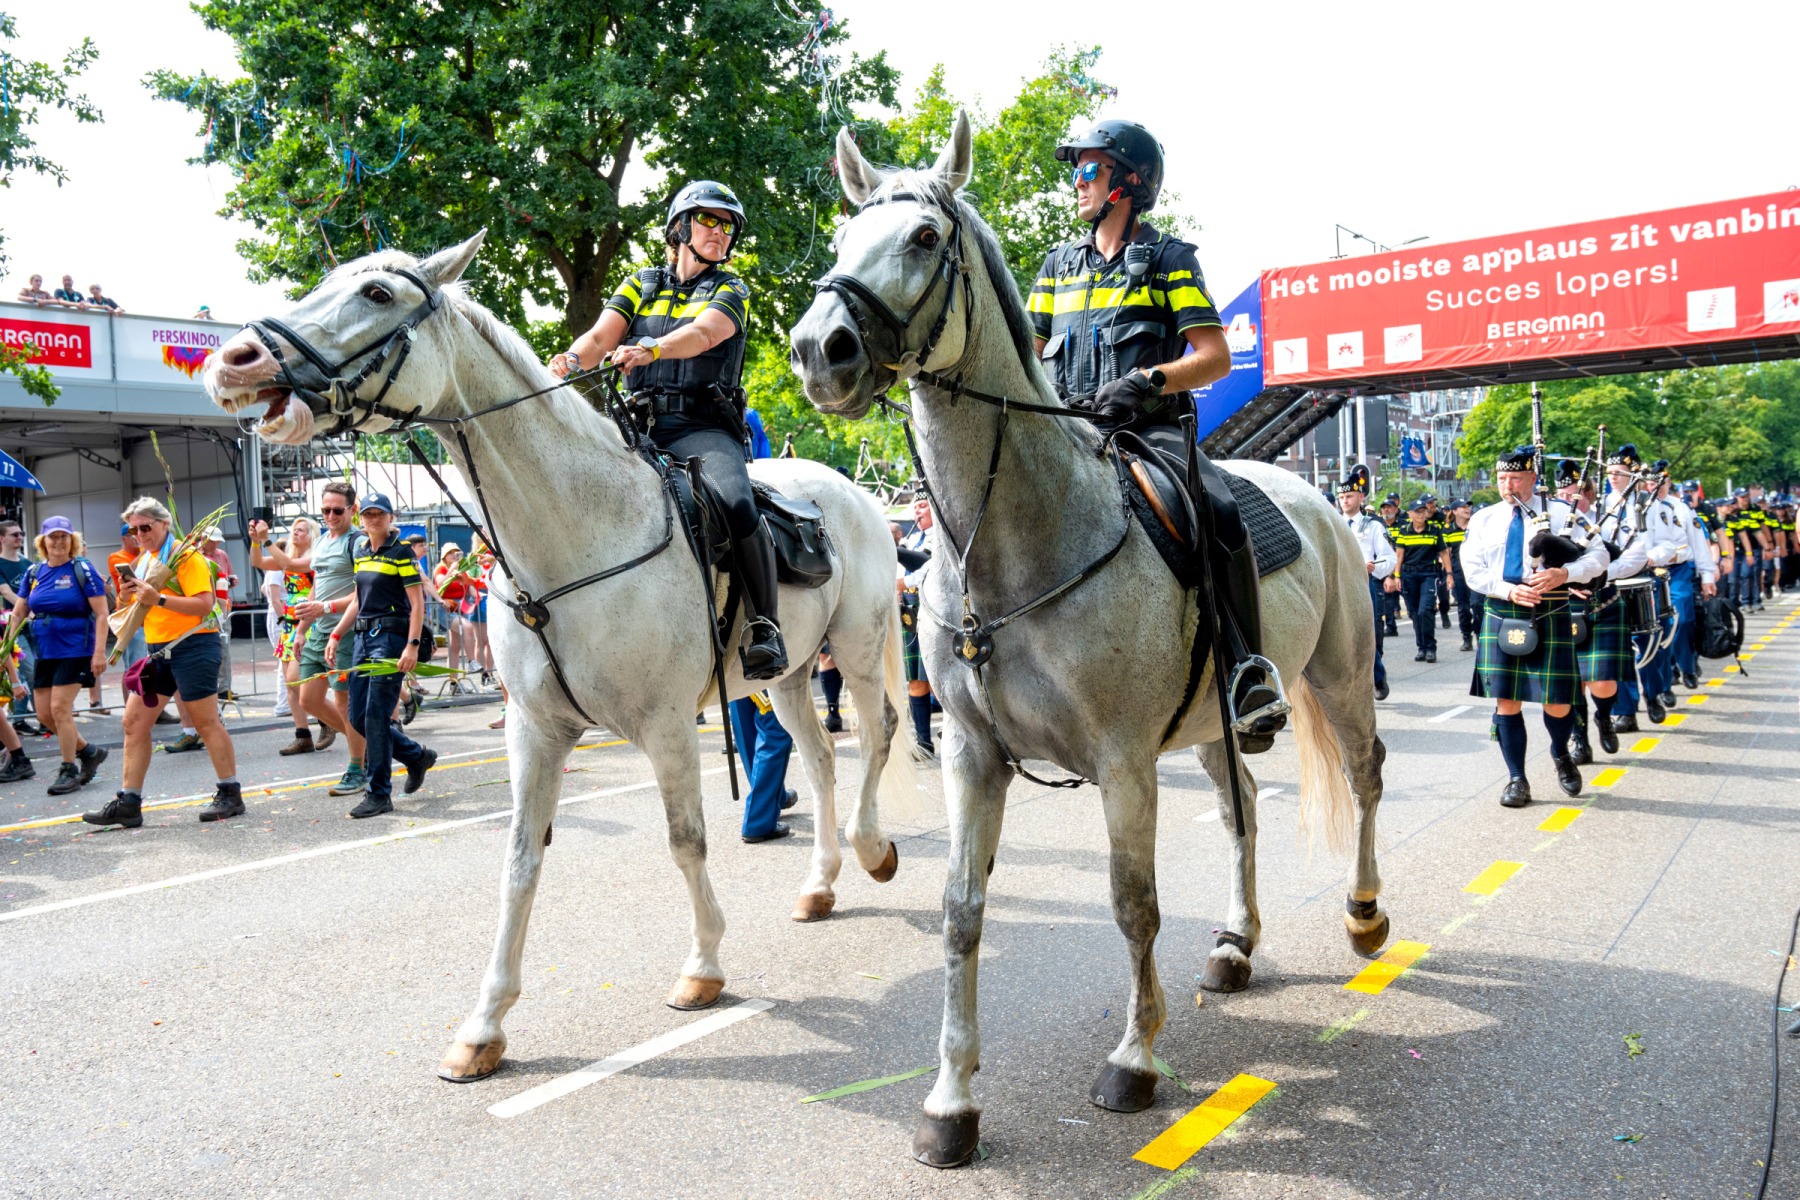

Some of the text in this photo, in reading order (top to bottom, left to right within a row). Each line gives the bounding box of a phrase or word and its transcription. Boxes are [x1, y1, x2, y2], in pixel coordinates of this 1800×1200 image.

[1271, 204, 1800, 299] Het mooiste applaus zit vanbin
[1426, 258, 1678, 311] Succes lopers!
[0, 328, 82, 350] RGMAN
[152, 329, 222, 347] PERSKINDOL
[1487, 311, 1605, 339] BERGMAN
